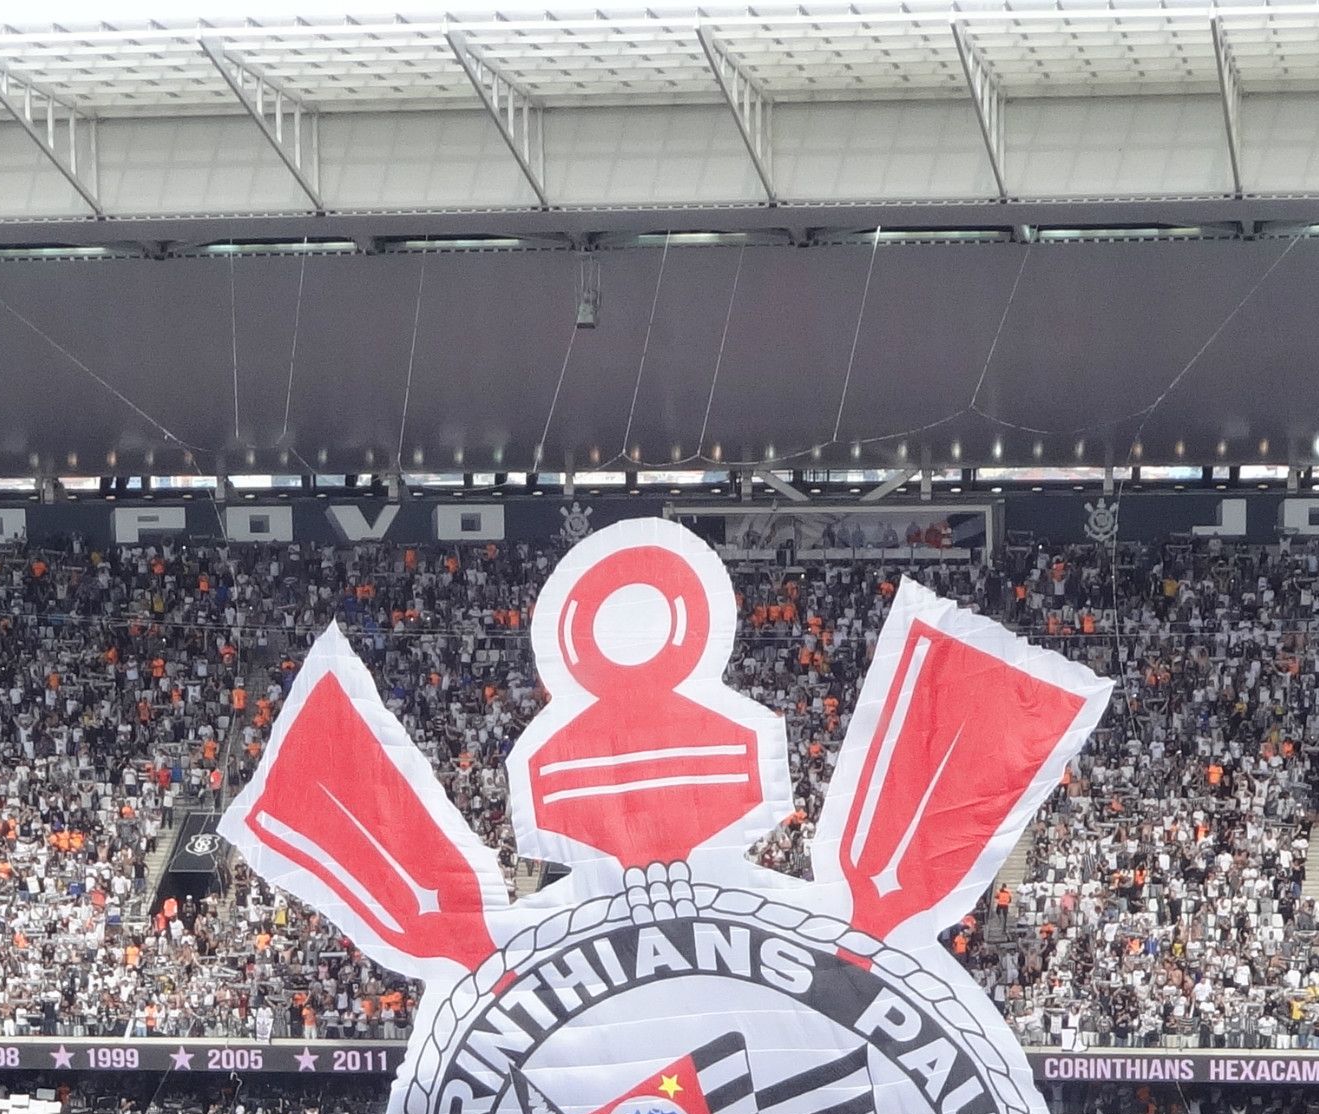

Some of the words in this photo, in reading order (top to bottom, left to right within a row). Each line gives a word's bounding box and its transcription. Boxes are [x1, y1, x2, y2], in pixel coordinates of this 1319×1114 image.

[110, 504, 505, 543] POVO
[86, 1048, 139, 1068] 1999
[207, 1049, 263, 1070] 2005
[332, 1050, 388, 1071] 2011
[1044, 1058, 1194, 1081] CORINTHIANS
